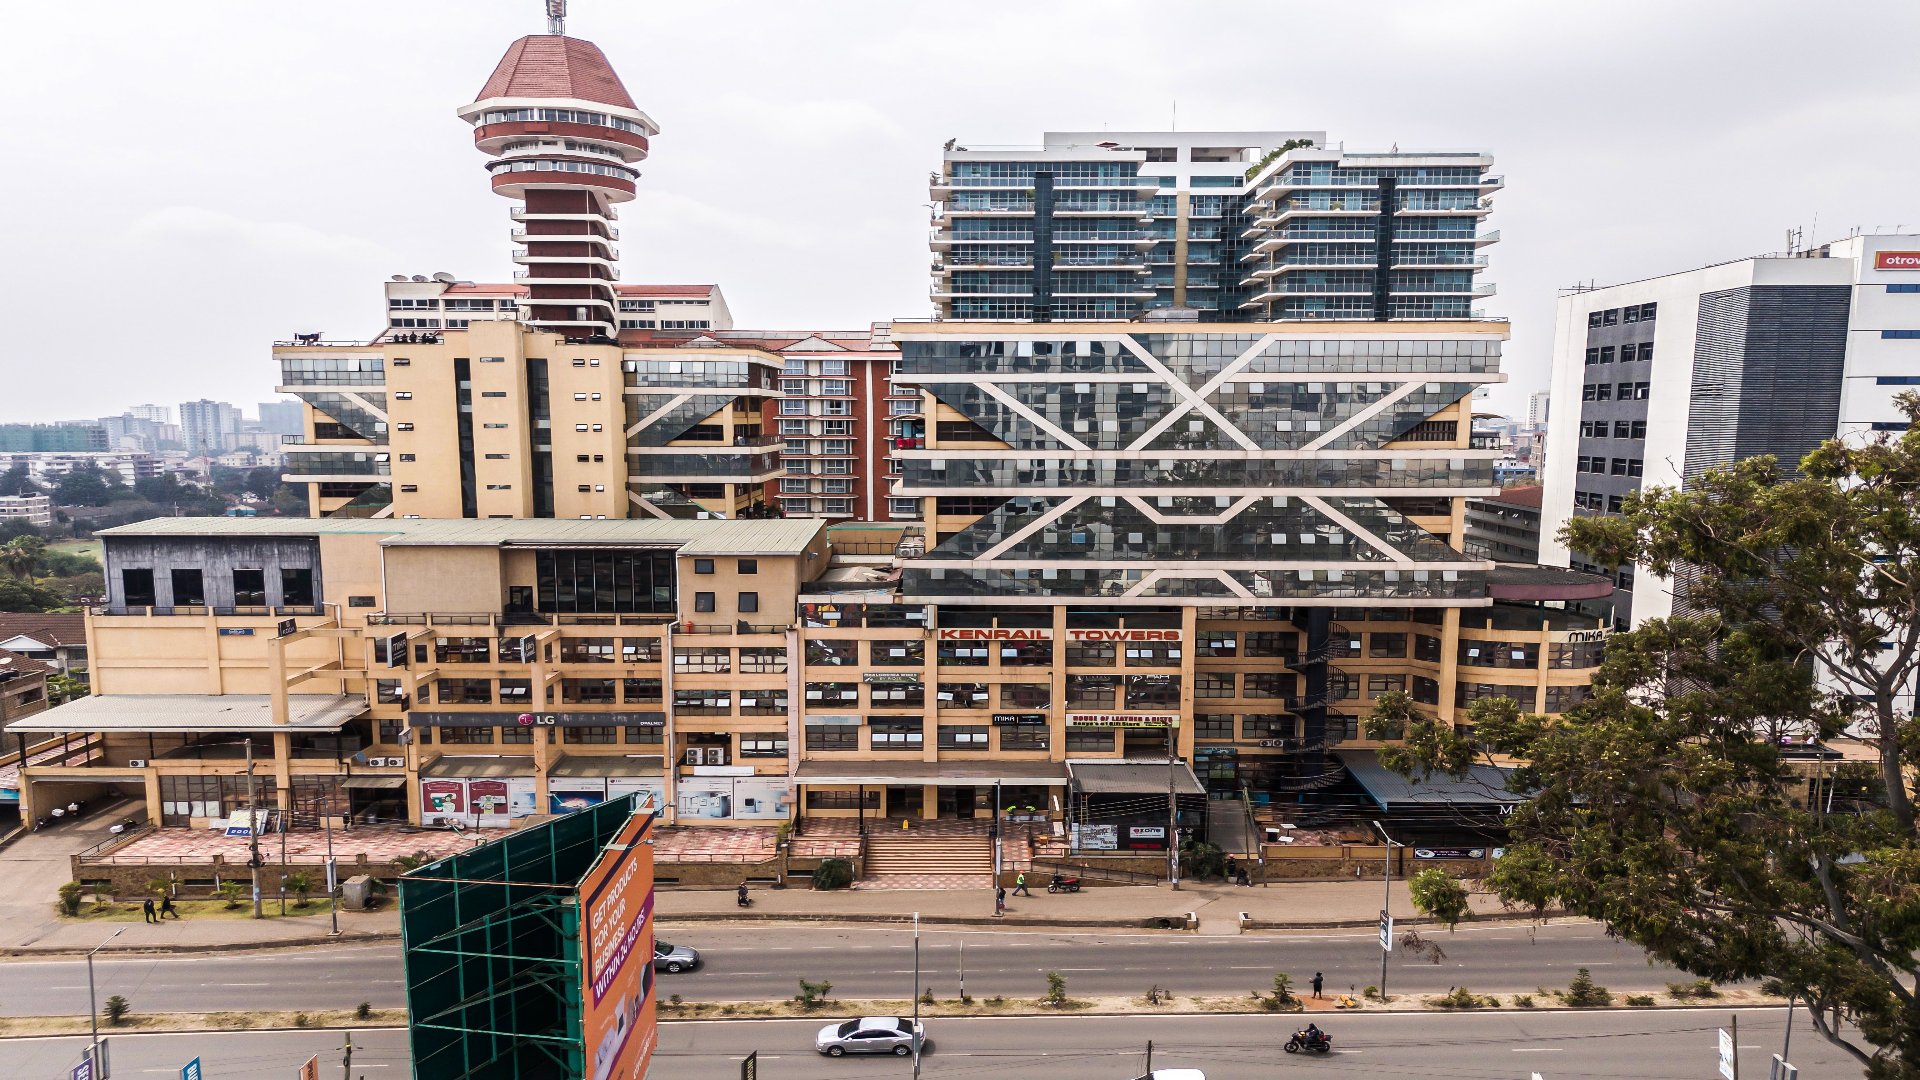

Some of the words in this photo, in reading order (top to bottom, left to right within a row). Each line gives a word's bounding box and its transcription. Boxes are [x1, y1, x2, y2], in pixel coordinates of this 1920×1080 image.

[940, 629, 1050, 640] KENRAIL
[1069, 630, 1180, 641] TOWERS
[1568, 631, 1603, 642] MIKA
[536, 715, 555, 725] LG
[593, 899, 607, 929] GET
[607, 857, 638, 911] PRODUCTS
[594, 923, 608, 954] FOR
[608, 897, 626, 930] YOUR
[595, 921, 626, 977] BUSINESS
[595, 951, 621, 998] WITHIN
